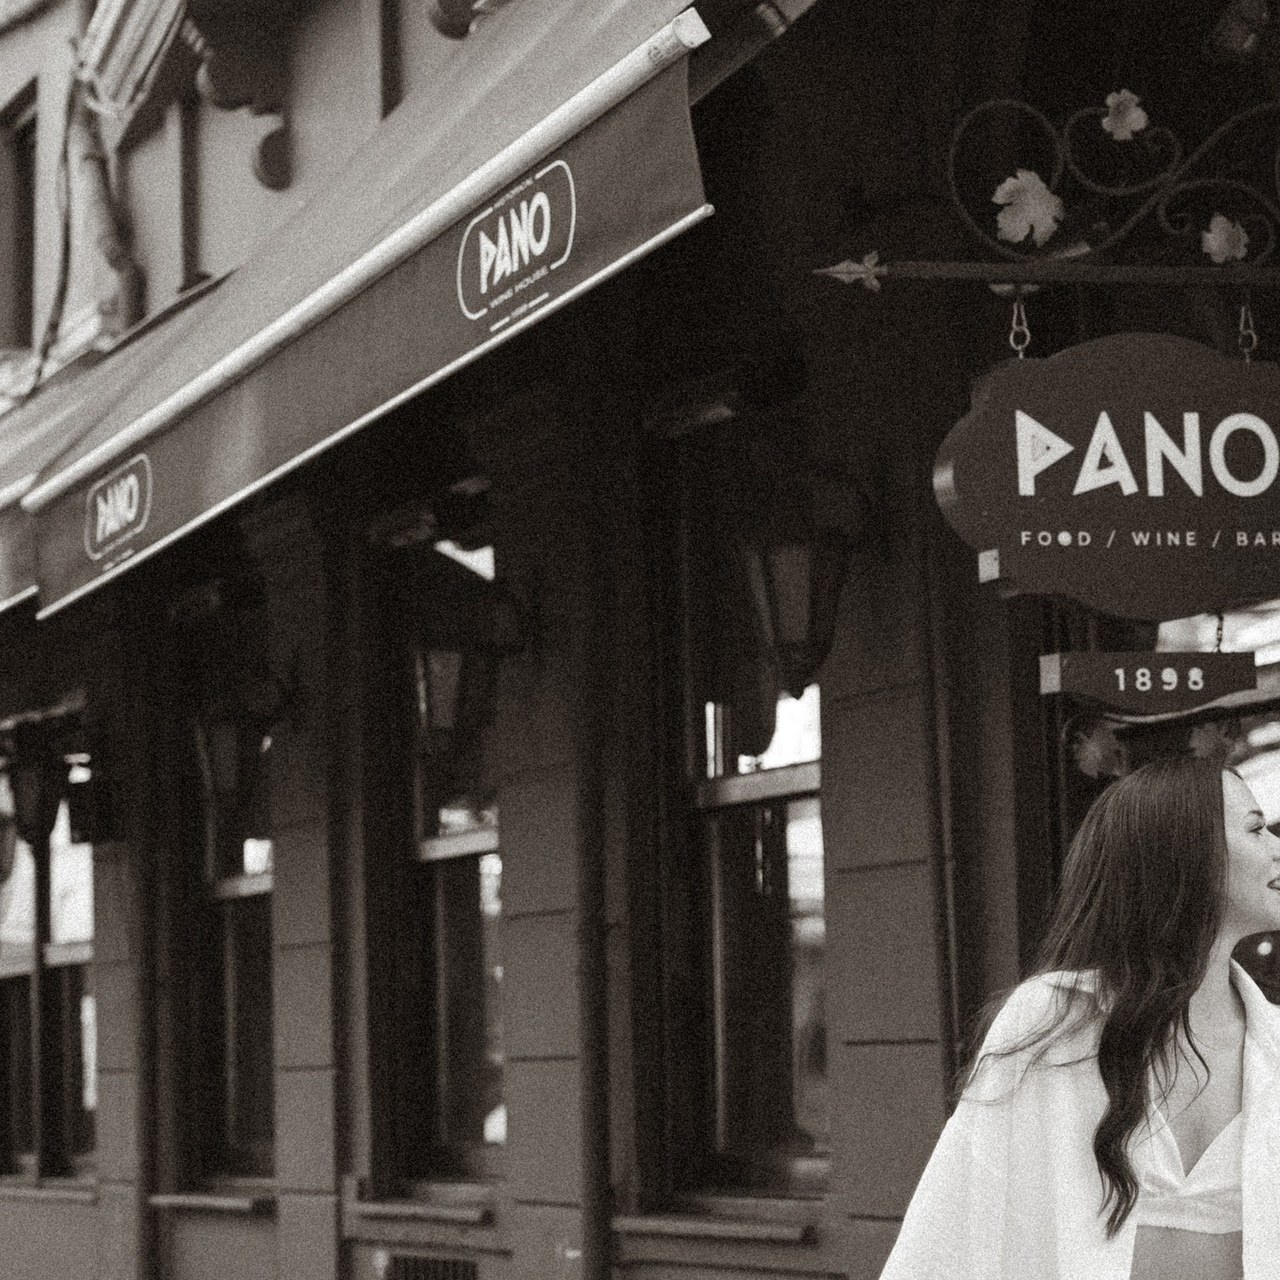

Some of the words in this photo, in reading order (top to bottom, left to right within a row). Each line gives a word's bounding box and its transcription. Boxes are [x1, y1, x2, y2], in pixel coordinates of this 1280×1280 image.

[479, 191, 551, 295] PANO
[1015, 410, 1280, 497] PANO
[1021, 531, 1092, 547] FOOD
[1132, 531, 1198, 547] WINE
[1114, 667, 1206, 692] 1898
